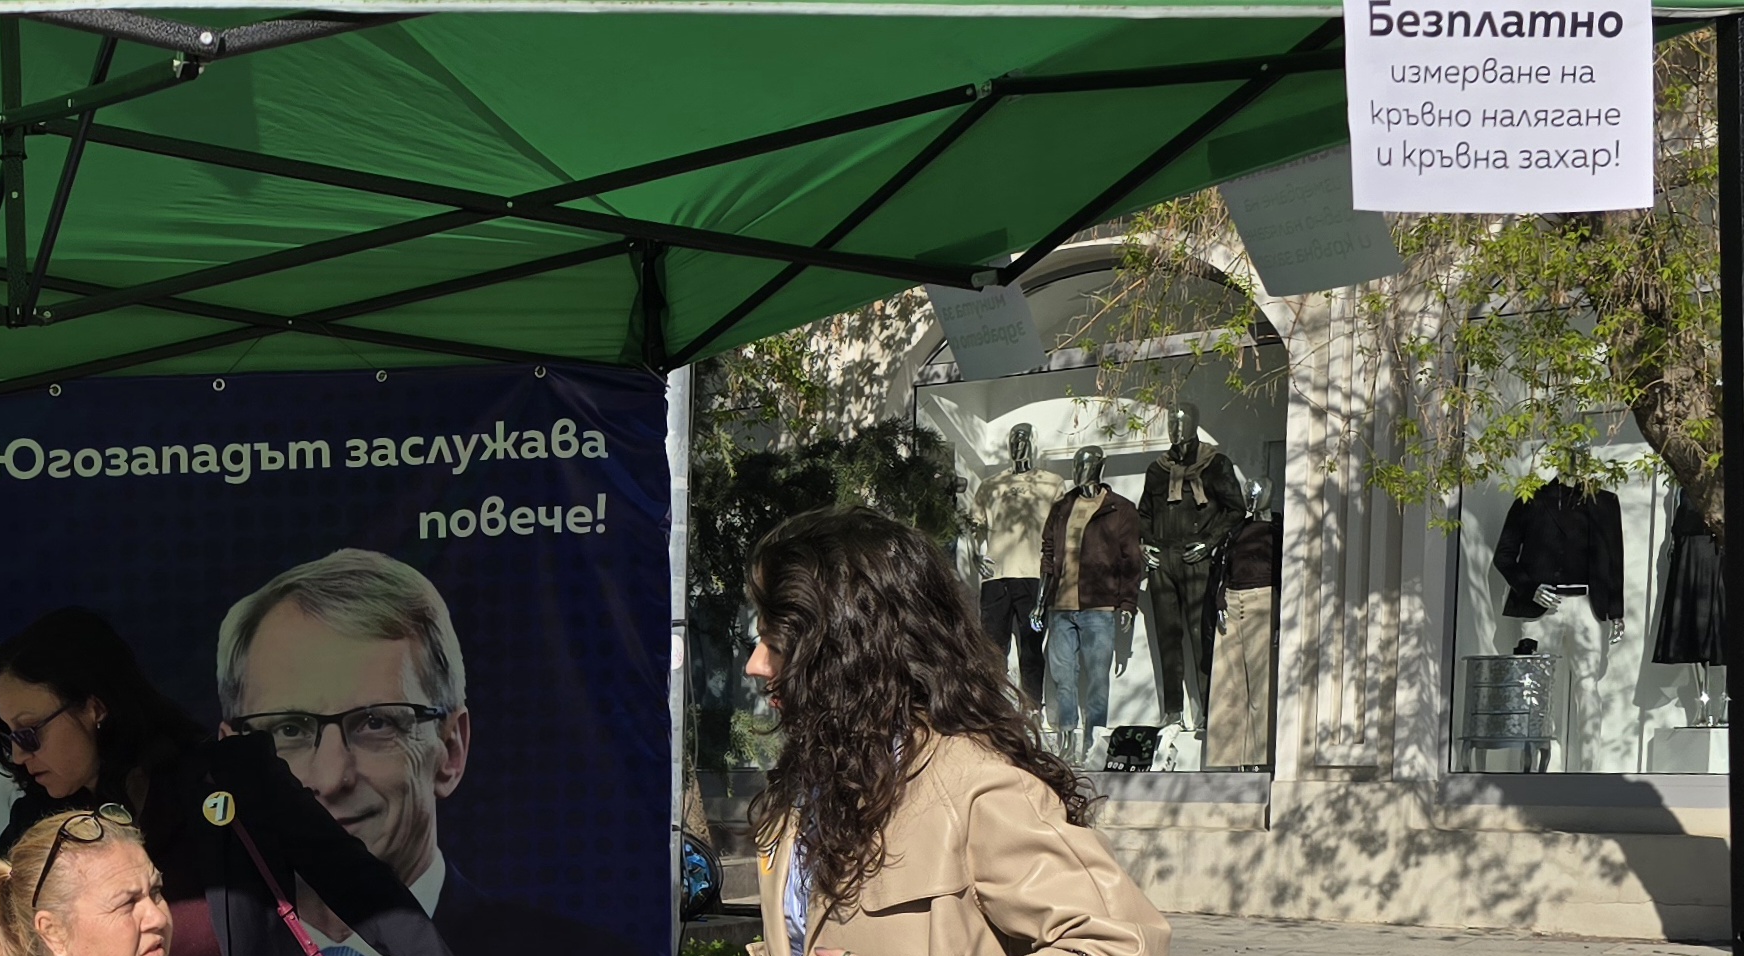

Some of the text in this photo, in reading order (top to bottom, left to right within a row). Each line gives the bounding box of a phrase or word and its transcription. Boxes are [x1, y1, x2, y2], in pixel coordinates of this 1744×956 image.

[1369, 0, 1623, 38] Безплатно
[1391, 57, 1596, 91] измерване на
[1370, 100, 1621, 130] кръвно налягане
[1377, 140, 1621, 174] и кръвна захар!
[345, 418, 609, 475] заслужава
[419, 492, 607, 540] повече!
